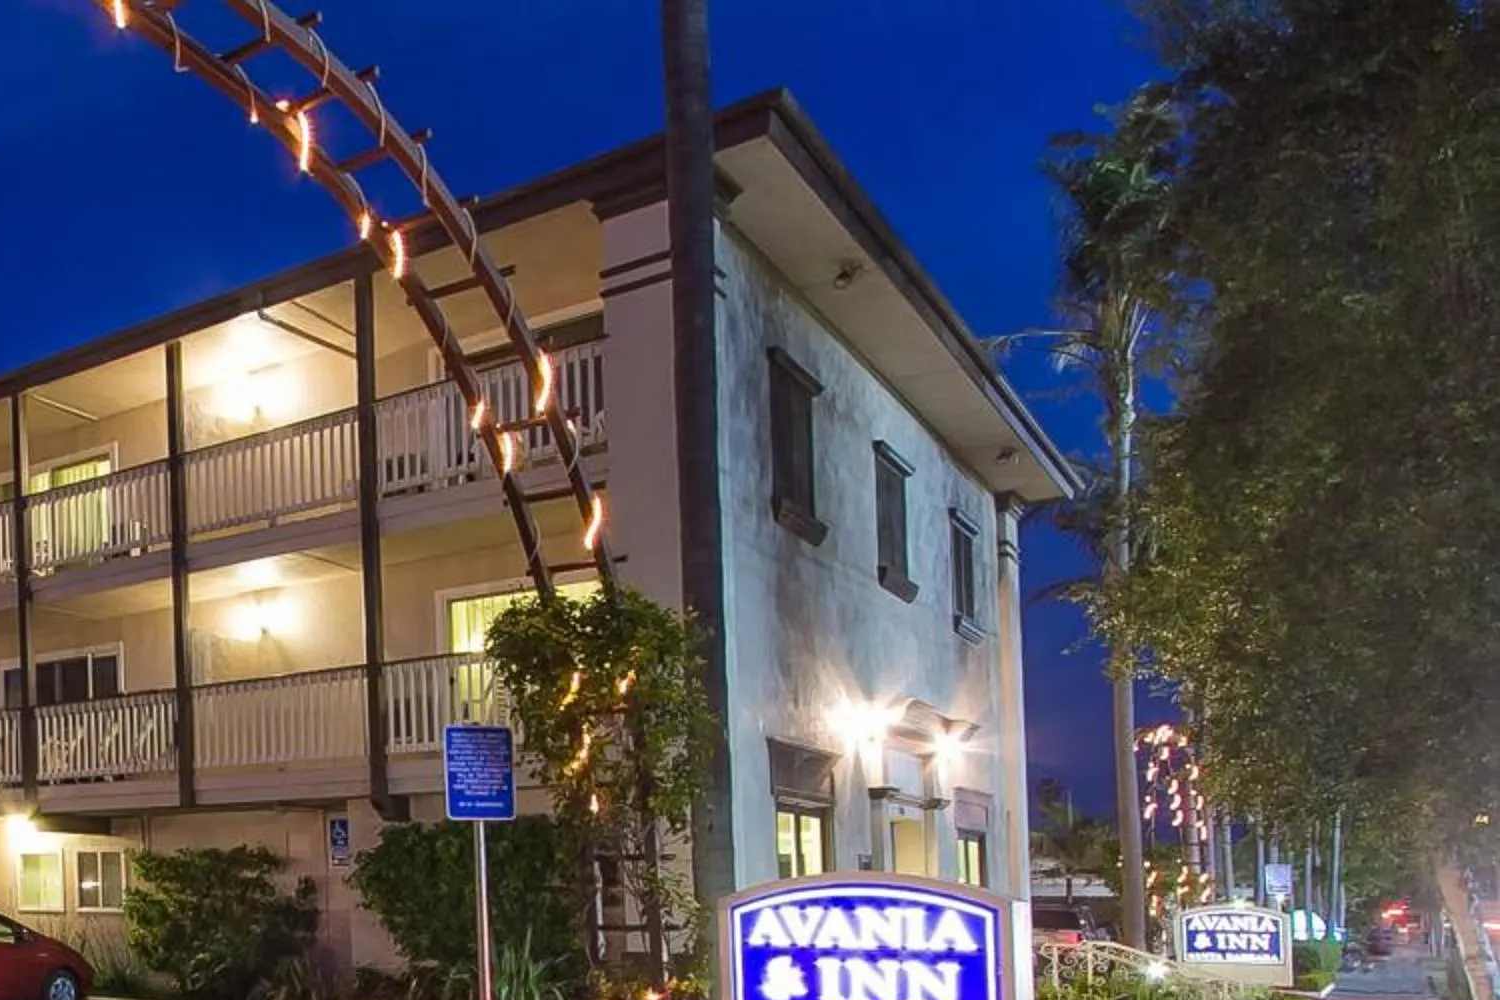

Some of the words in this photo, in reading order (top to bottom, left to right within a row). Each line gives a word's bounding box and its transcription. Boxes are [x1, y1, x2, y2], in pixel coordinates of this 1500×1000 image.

[747, 906, 979, 951] AVANIA
[1188, 916, 1276, 932] AVANIA
[1217, 933, 1271, 950] INN
